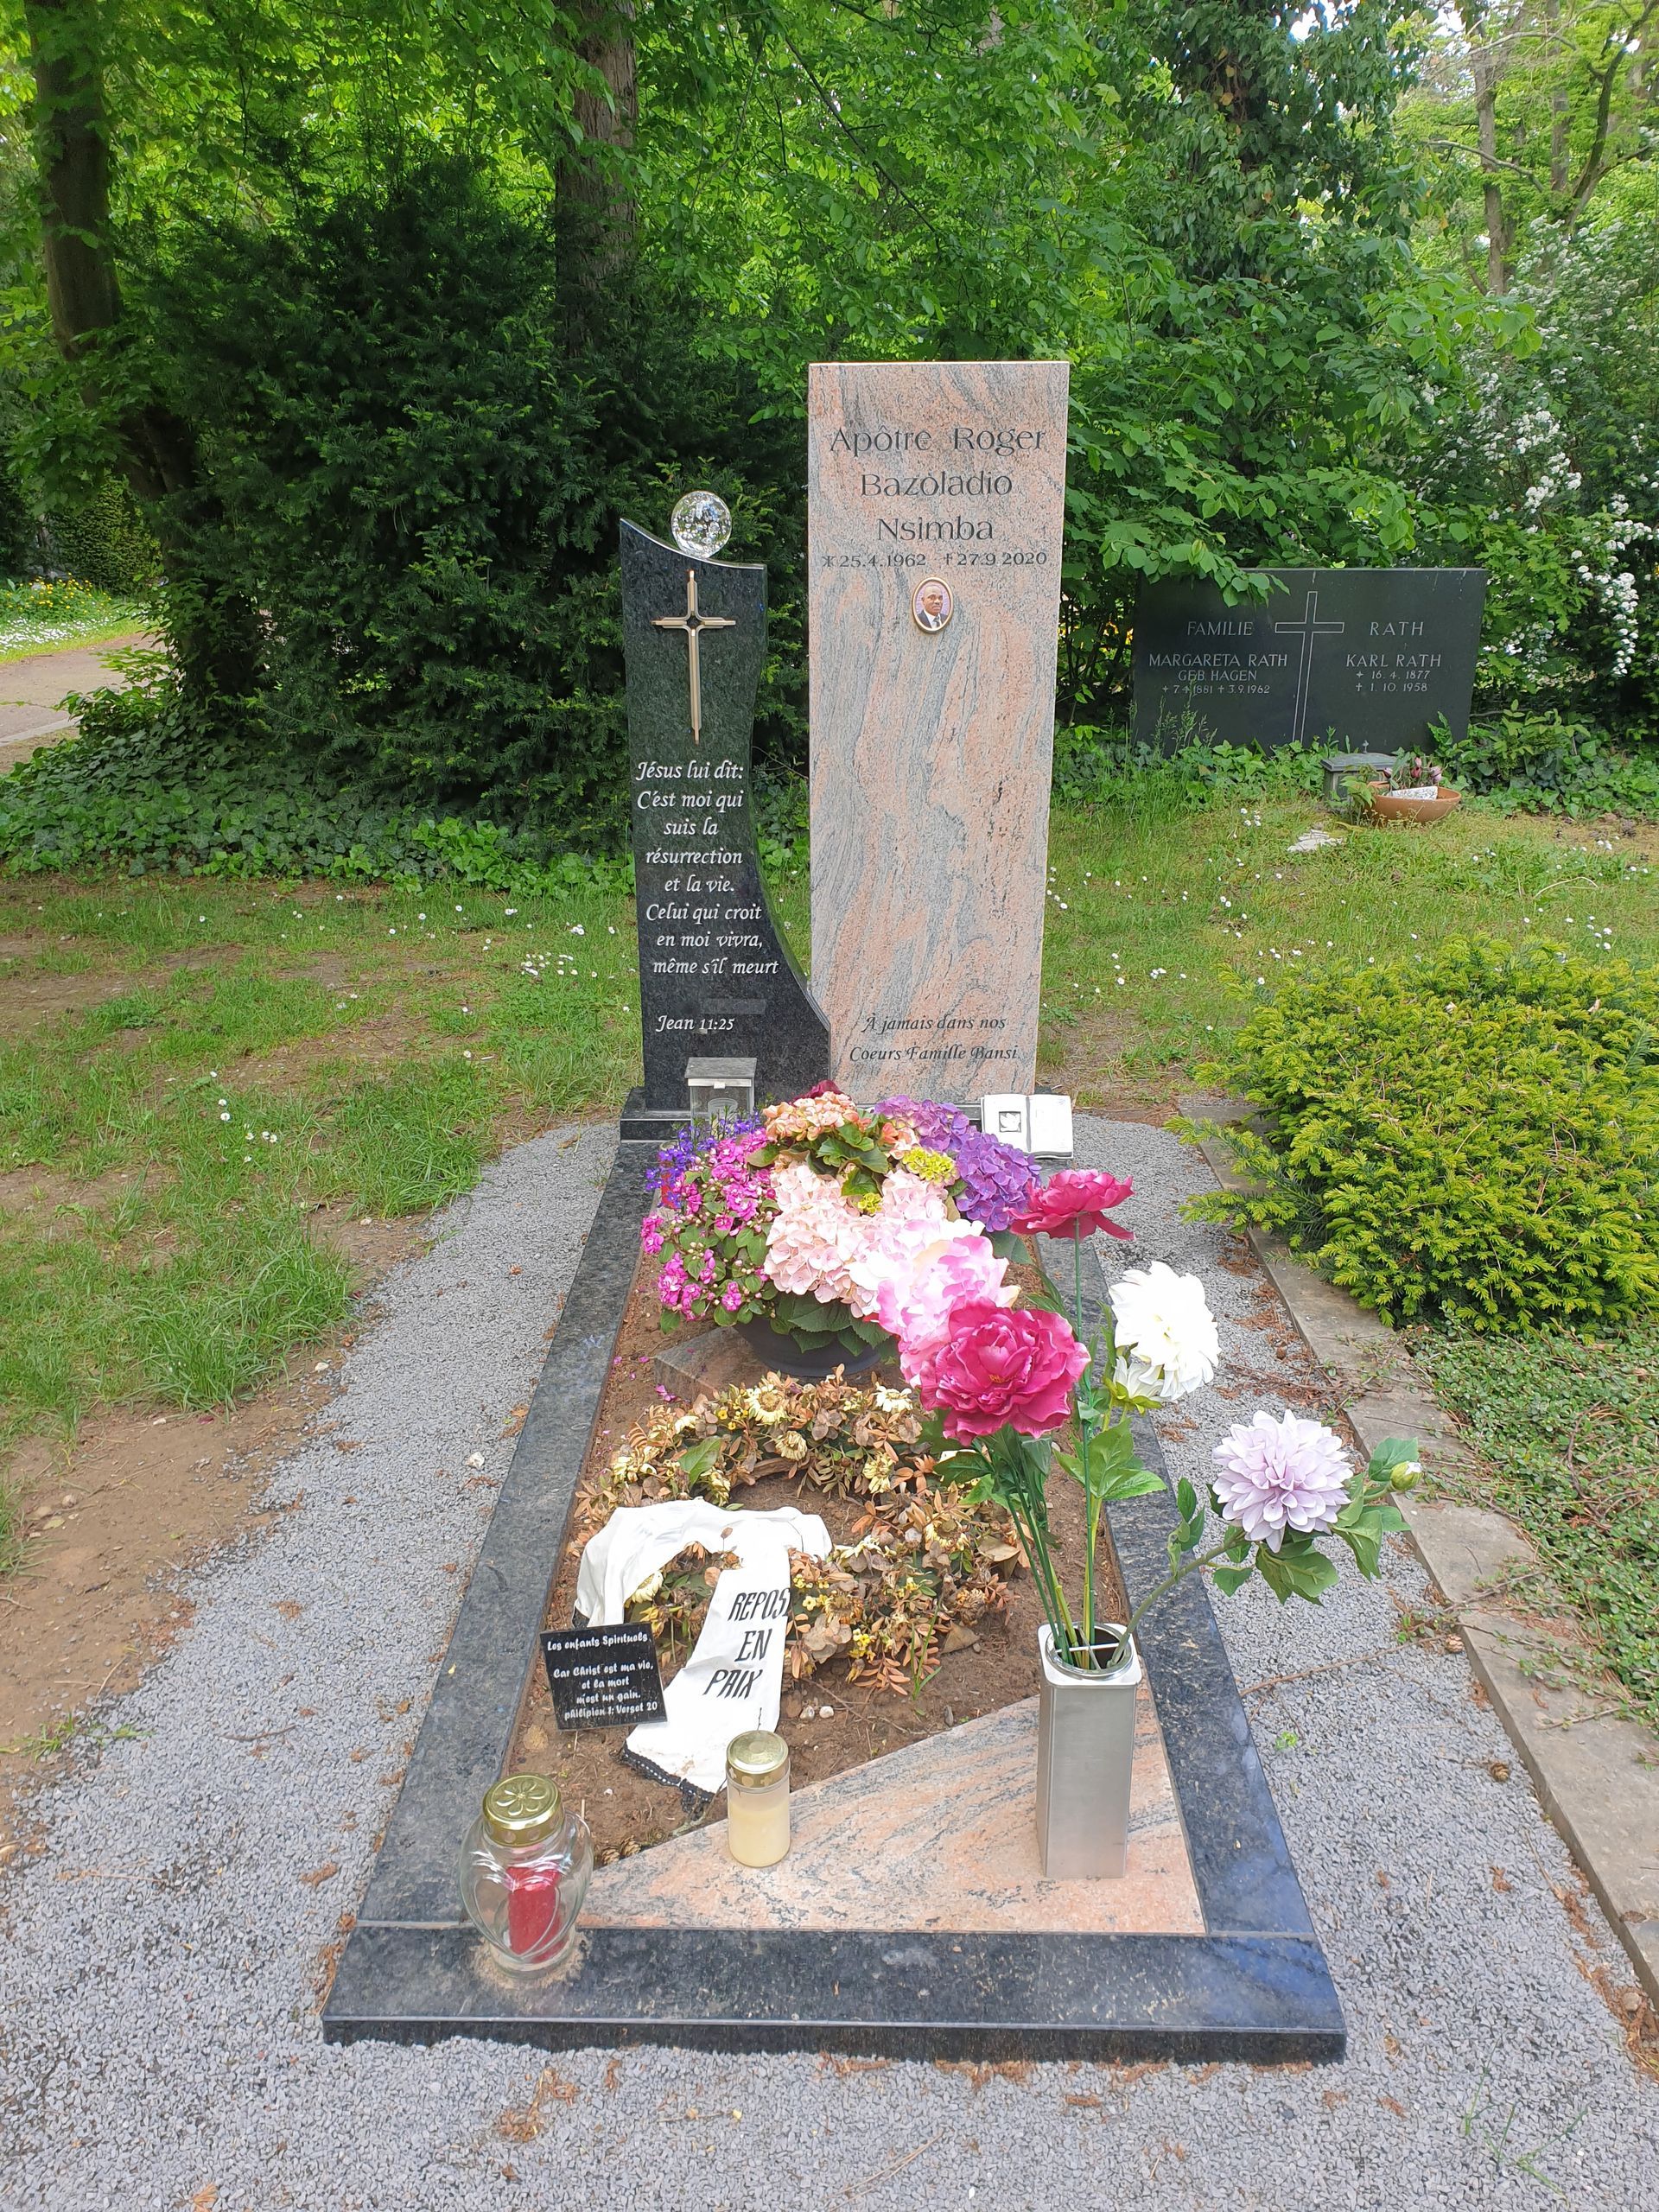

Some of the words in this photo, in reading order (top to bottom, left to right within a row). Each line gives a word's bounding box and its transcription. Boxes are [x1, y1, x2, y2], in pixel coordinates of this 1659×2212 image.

[830, 425, 932, 457] Apôtre
[954, 427, 1046, 457] Roger
[861, 471, 1014, 497] Bazoladio
[878, 516, 994, 541] Nsimba
[1186, 621, 1253, 636] FAMILIE
[1370, 621, 1425, 636] RATH
[1148, 653, 1241, 667] MARGARETA
[1248, 653, 1287, 667] RATH
[1345, 654, 1389, 667] KARL
[1395, 654, 1442, 667] RATH
[1211, 670, 1257, 681] HAGEN
[1402, 683, 1427, 691] 1958
[635, 760, 683, 780] Jésus
[687, 760, 711, 779] lui
[714, 760, 744, 779] dit:
[637, 791, 677, 809] C'est
[682, 790, 713, 807] moi
[715, 790, 745, 813] qui
[664, 818, 696, 835] suis
[702, 817, 719, 835] la
[645, 848, 743, 864] résurrection
[664, 875, 680, 892] et
[686, 874, 702, 892] la
[707, 875, 735, 892] vie.
[646, 902, 690, 921] Celui
[692, 903, 720, 925] qui
[724, 903, 762, 919] croit
[657, 934, 676, 946] en
[681, 931, 710, 947] moi
[716, 931, 763, 949] vivra,
[653, 958, 698, 974] même
[732, 961, 779, 974] meurt
[655, 1015, 695, 1032] Jean
[698, 1018, 735, 1031] 11:25
[861, 1013, 877, 1033] À
[877, 1015, 934, 1035] jamais
[937, 1014, 976, 1029] dans
[979, 1016, 1007, 1029] nos
[849, 1046, 904, 1061] Coeurs
[906, 1043, 968, 1060] Famille
[970, 1045, 1018, 1059] Bansi
[547, 1641, 563, 1651] Les
[564, 1637, 600, 1650] enfants
[734, 1628, 772, 1662] EN
[553, 1669, 570, 1678] Car
[573, 1665, 601, 1677] Christ
[603, 1662, 618, 1674] est
[620, 1663, 636, 1673] ma
[638, 1659, 654, 1670] vie,
[582, 1680, 591, 1689] et
[594, 1679, 605, 1688] la
[607, 1675, 630, 1688] mort
[702, 1669, 763, 1700] PAIX
[602, 1694, 614, 1702] un
[617, 1689, 641, 1702] gain.
[616, 1702, 644, 1714] Verset
[646, 1701, 658, 1711] 20
